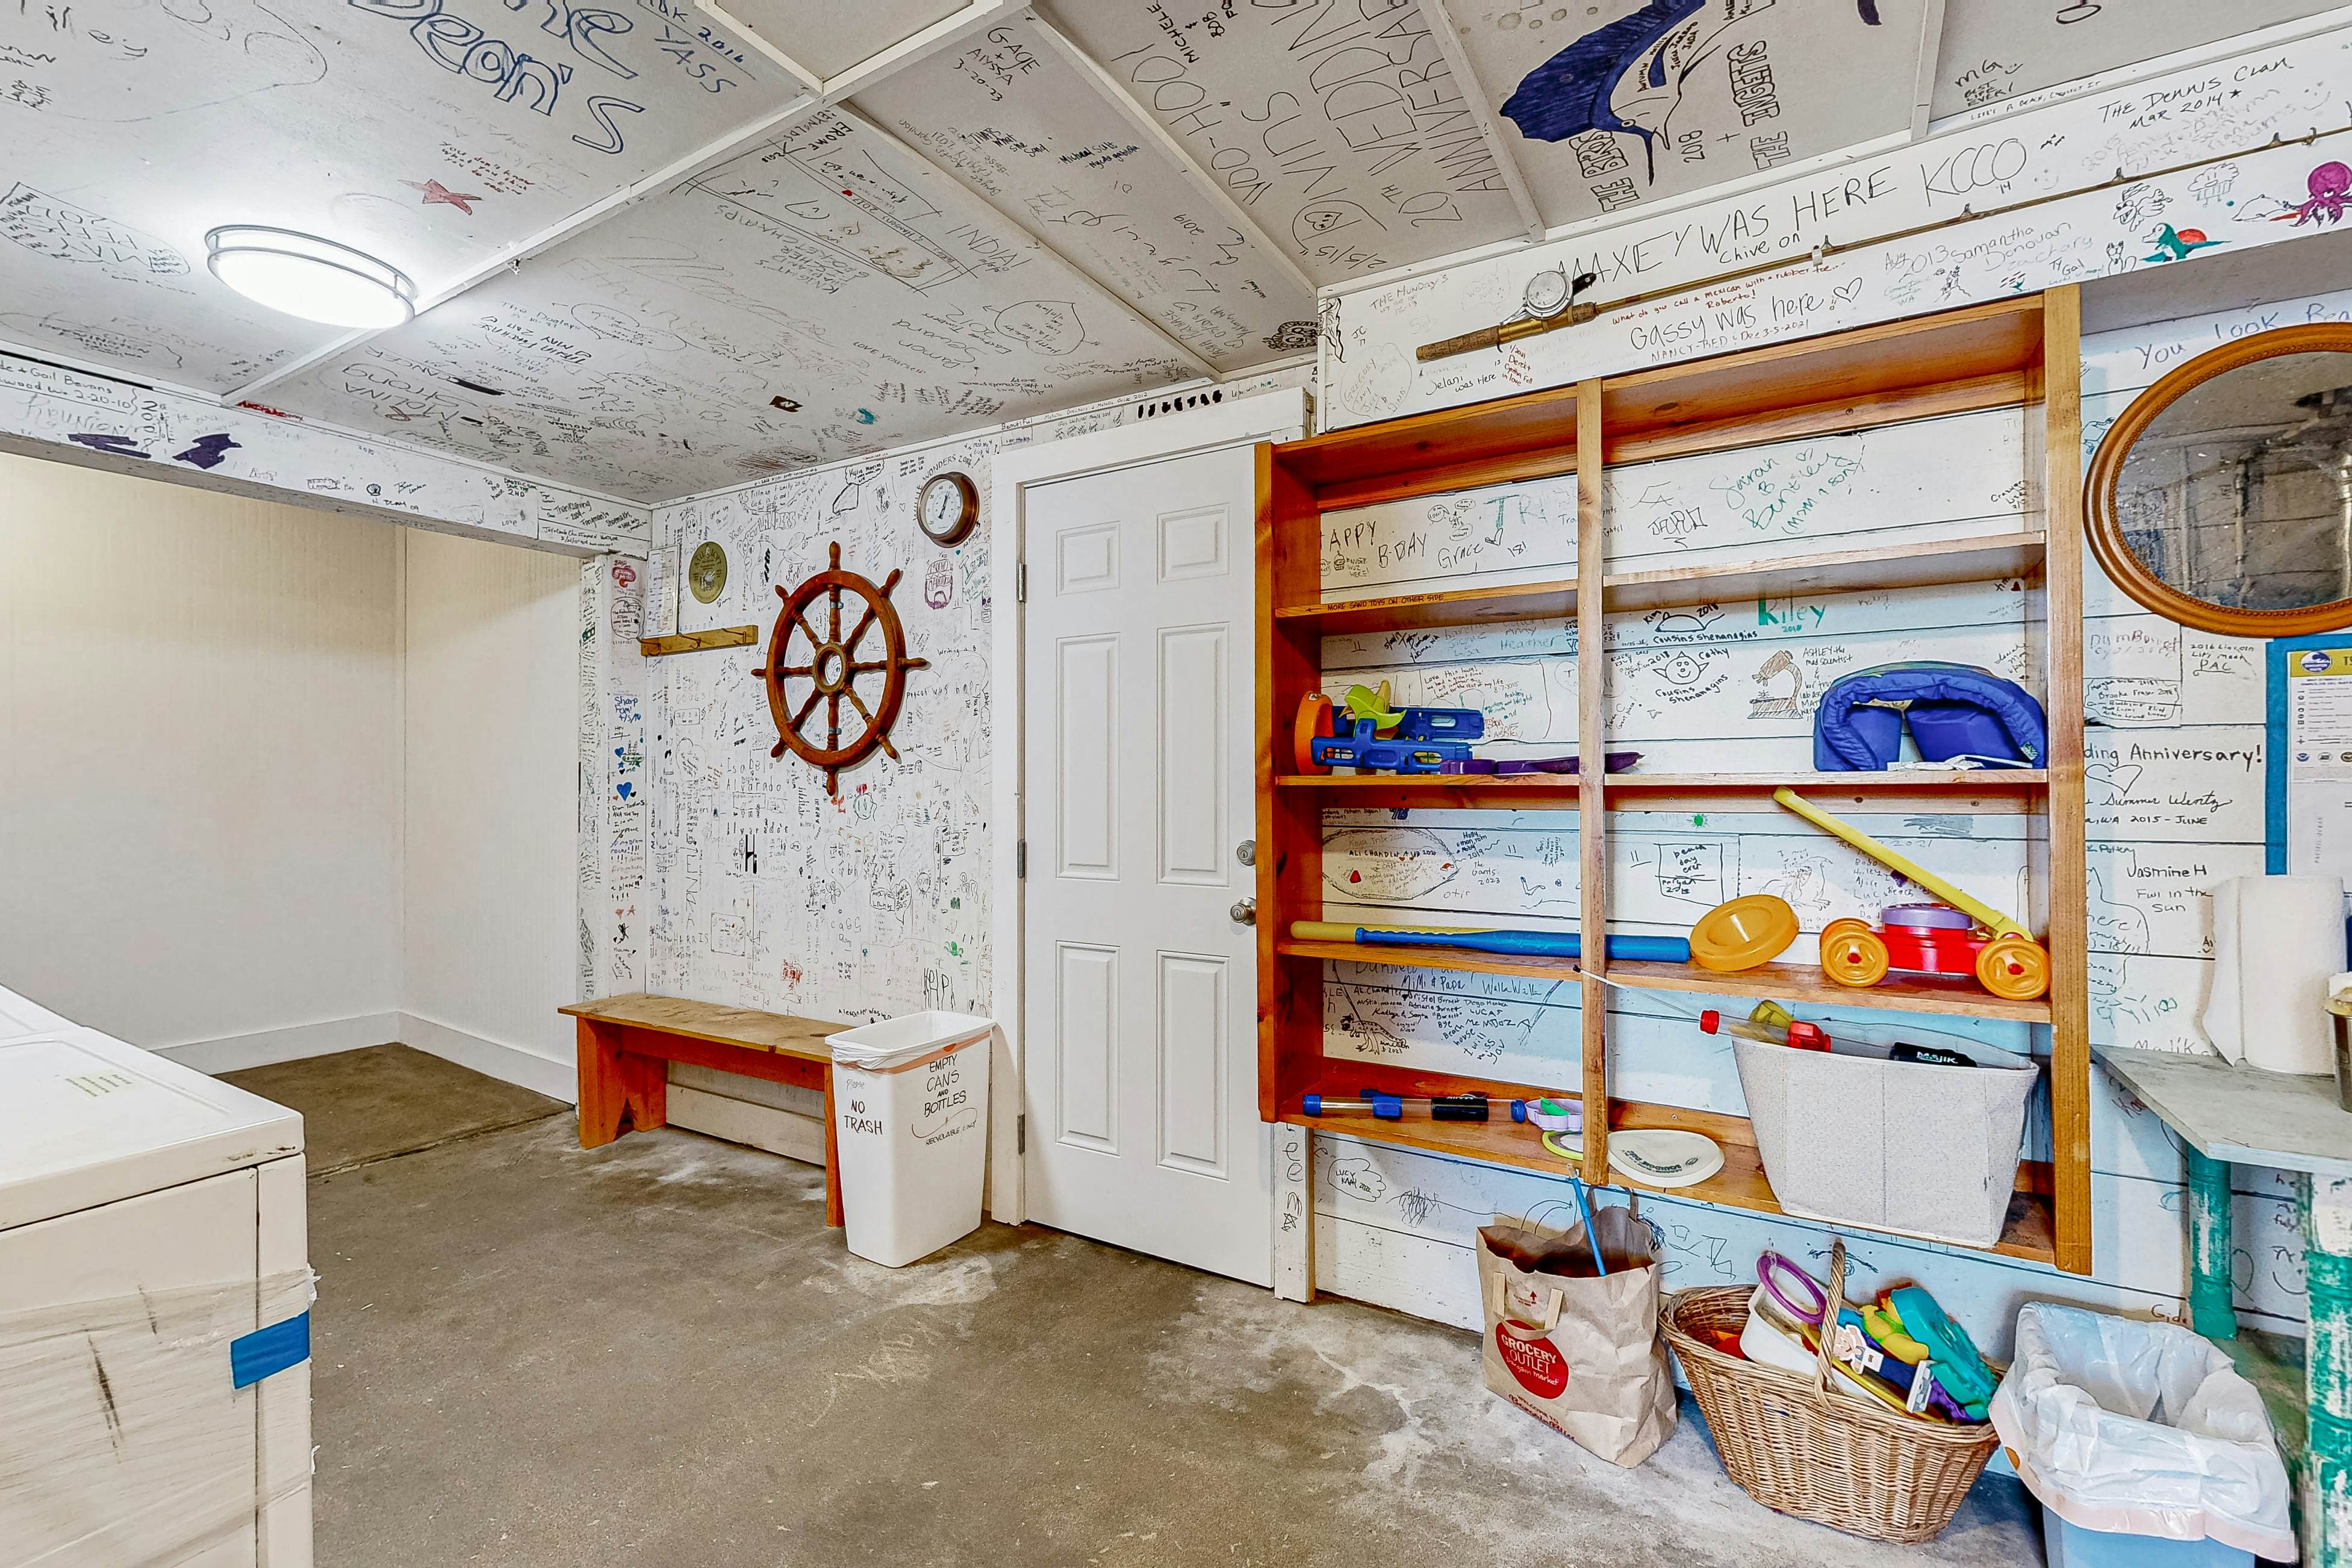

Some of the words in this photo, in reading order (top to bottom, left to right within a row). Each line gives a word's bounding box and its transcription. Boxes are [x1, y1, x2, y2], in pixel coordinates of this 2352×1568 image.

[1251, 0, 1421, 176] WEDDIN
[2180, 92, 2223, 114] 2014
[1699, 204, 1770, 255] WAS
[1792, 166, 1898, 232] HERE
[1327, 603, 1346, 612] MORE
[1349, 600, 1367, 609] SAND
[1401, 595, 1425, 604] OTHER
[1426, 593, 1445, 602] SIDE
[2130, 742, 2263, 773] Anniversary!
[929, 1053, 958, 1073] EMPTY
[926, 1069, 960, 1093] CANS
[850, 1098, 866, 1115] NO
[923, 1089, 967, 1118] BOTTLES
[843, 1115, 883, 1136] TRASH
[1501, 1334, 1557, 1364] GROCERY
[1509, 1349, 1551, 1375] OUTLET
